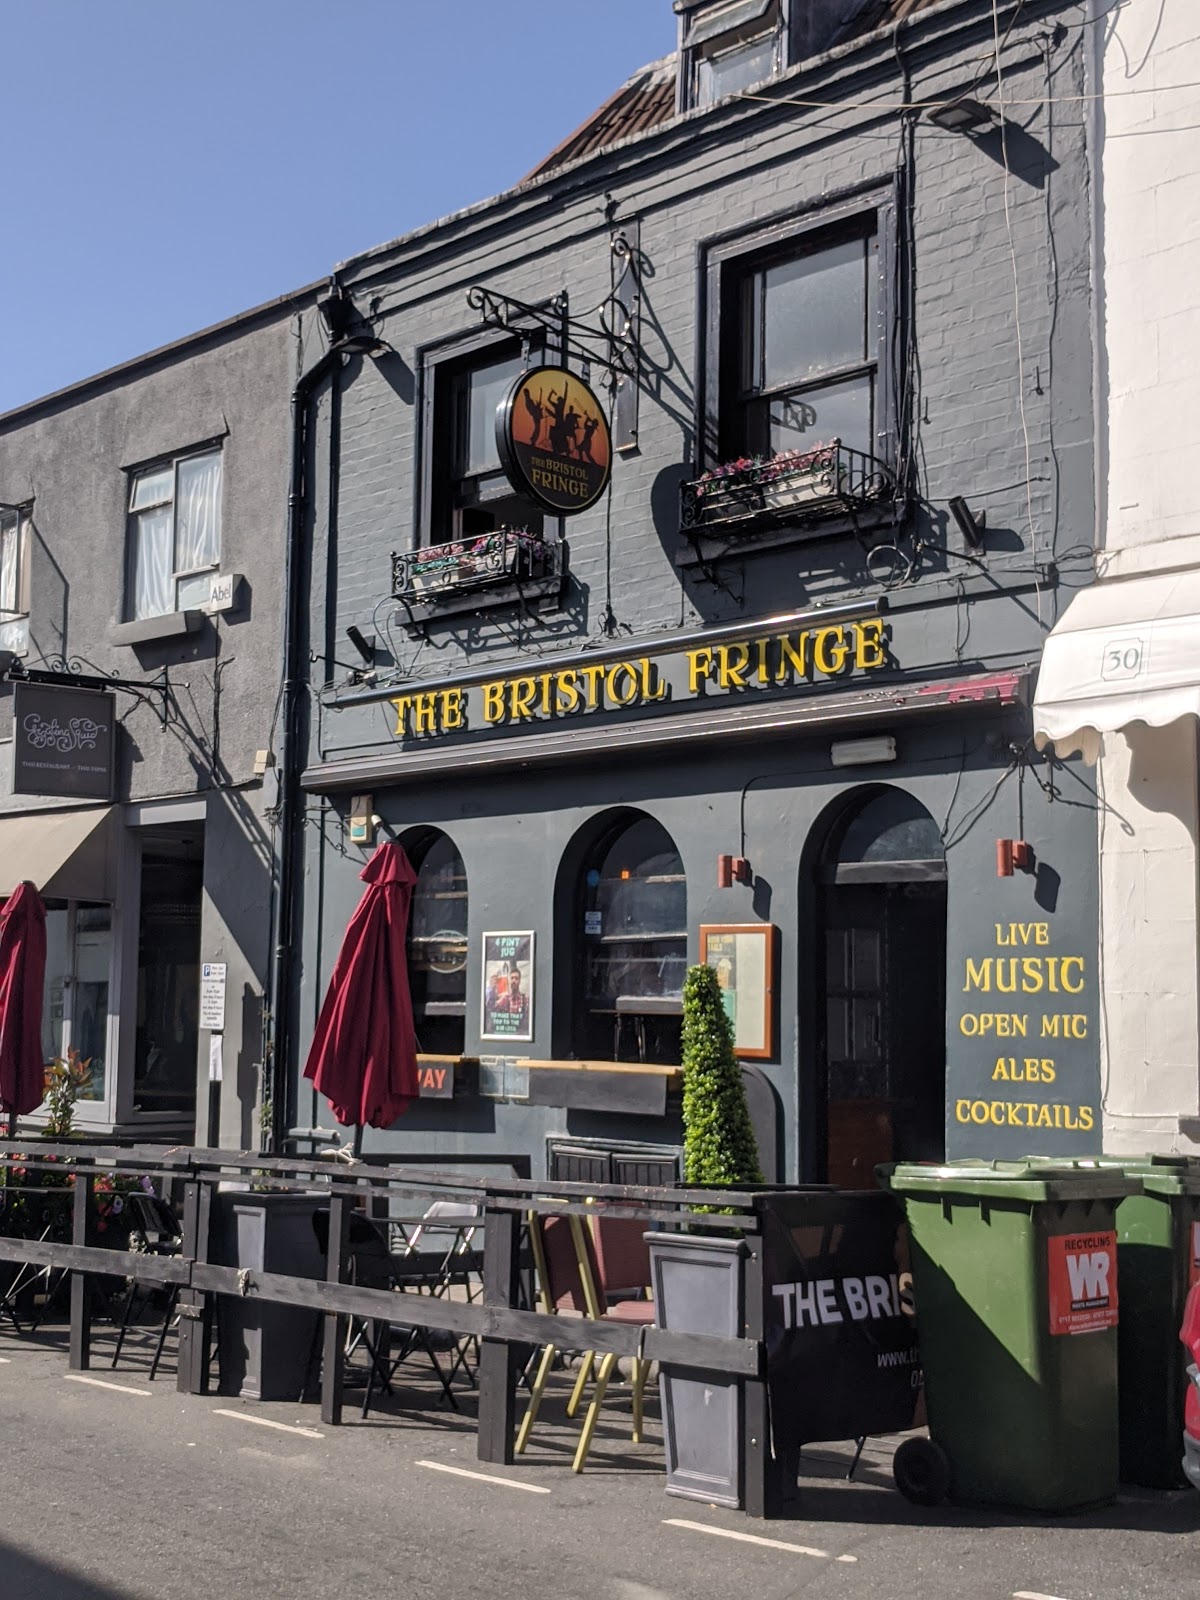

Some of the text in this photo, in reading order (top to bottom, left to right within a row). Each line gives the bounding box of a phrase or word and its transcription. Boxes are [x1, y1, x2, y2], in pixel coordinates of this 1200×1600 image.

[546, 459, 588, 480] BRISTOL
[532, 468, 588, 498] FRINGE
[211, 583, 231, 603] Abel
[1107, 648, 1139, 672] 30
[392, 618, 884, 736] THE BRISTOL FRINGE
[501, 938, 520, 946] PINT
[995, 923, 1049, 945] LIVE
[501, 948, 515, 957] JUG
[962, 956, 1085, 993] MUSIC
[960, 1013, 1087, 1038] OPEN MIC
[418, 1068, 446, 1088] AY
[992, 1058, 1056, 1083] ALES
[955, 1099, 1094, 1131] COCKTAILS
[1065, 1236, 1111, 1250] RECYCLING
[1066, 1251, 1110, 1300] WR
[772, 1279, 843, 1329] THE
